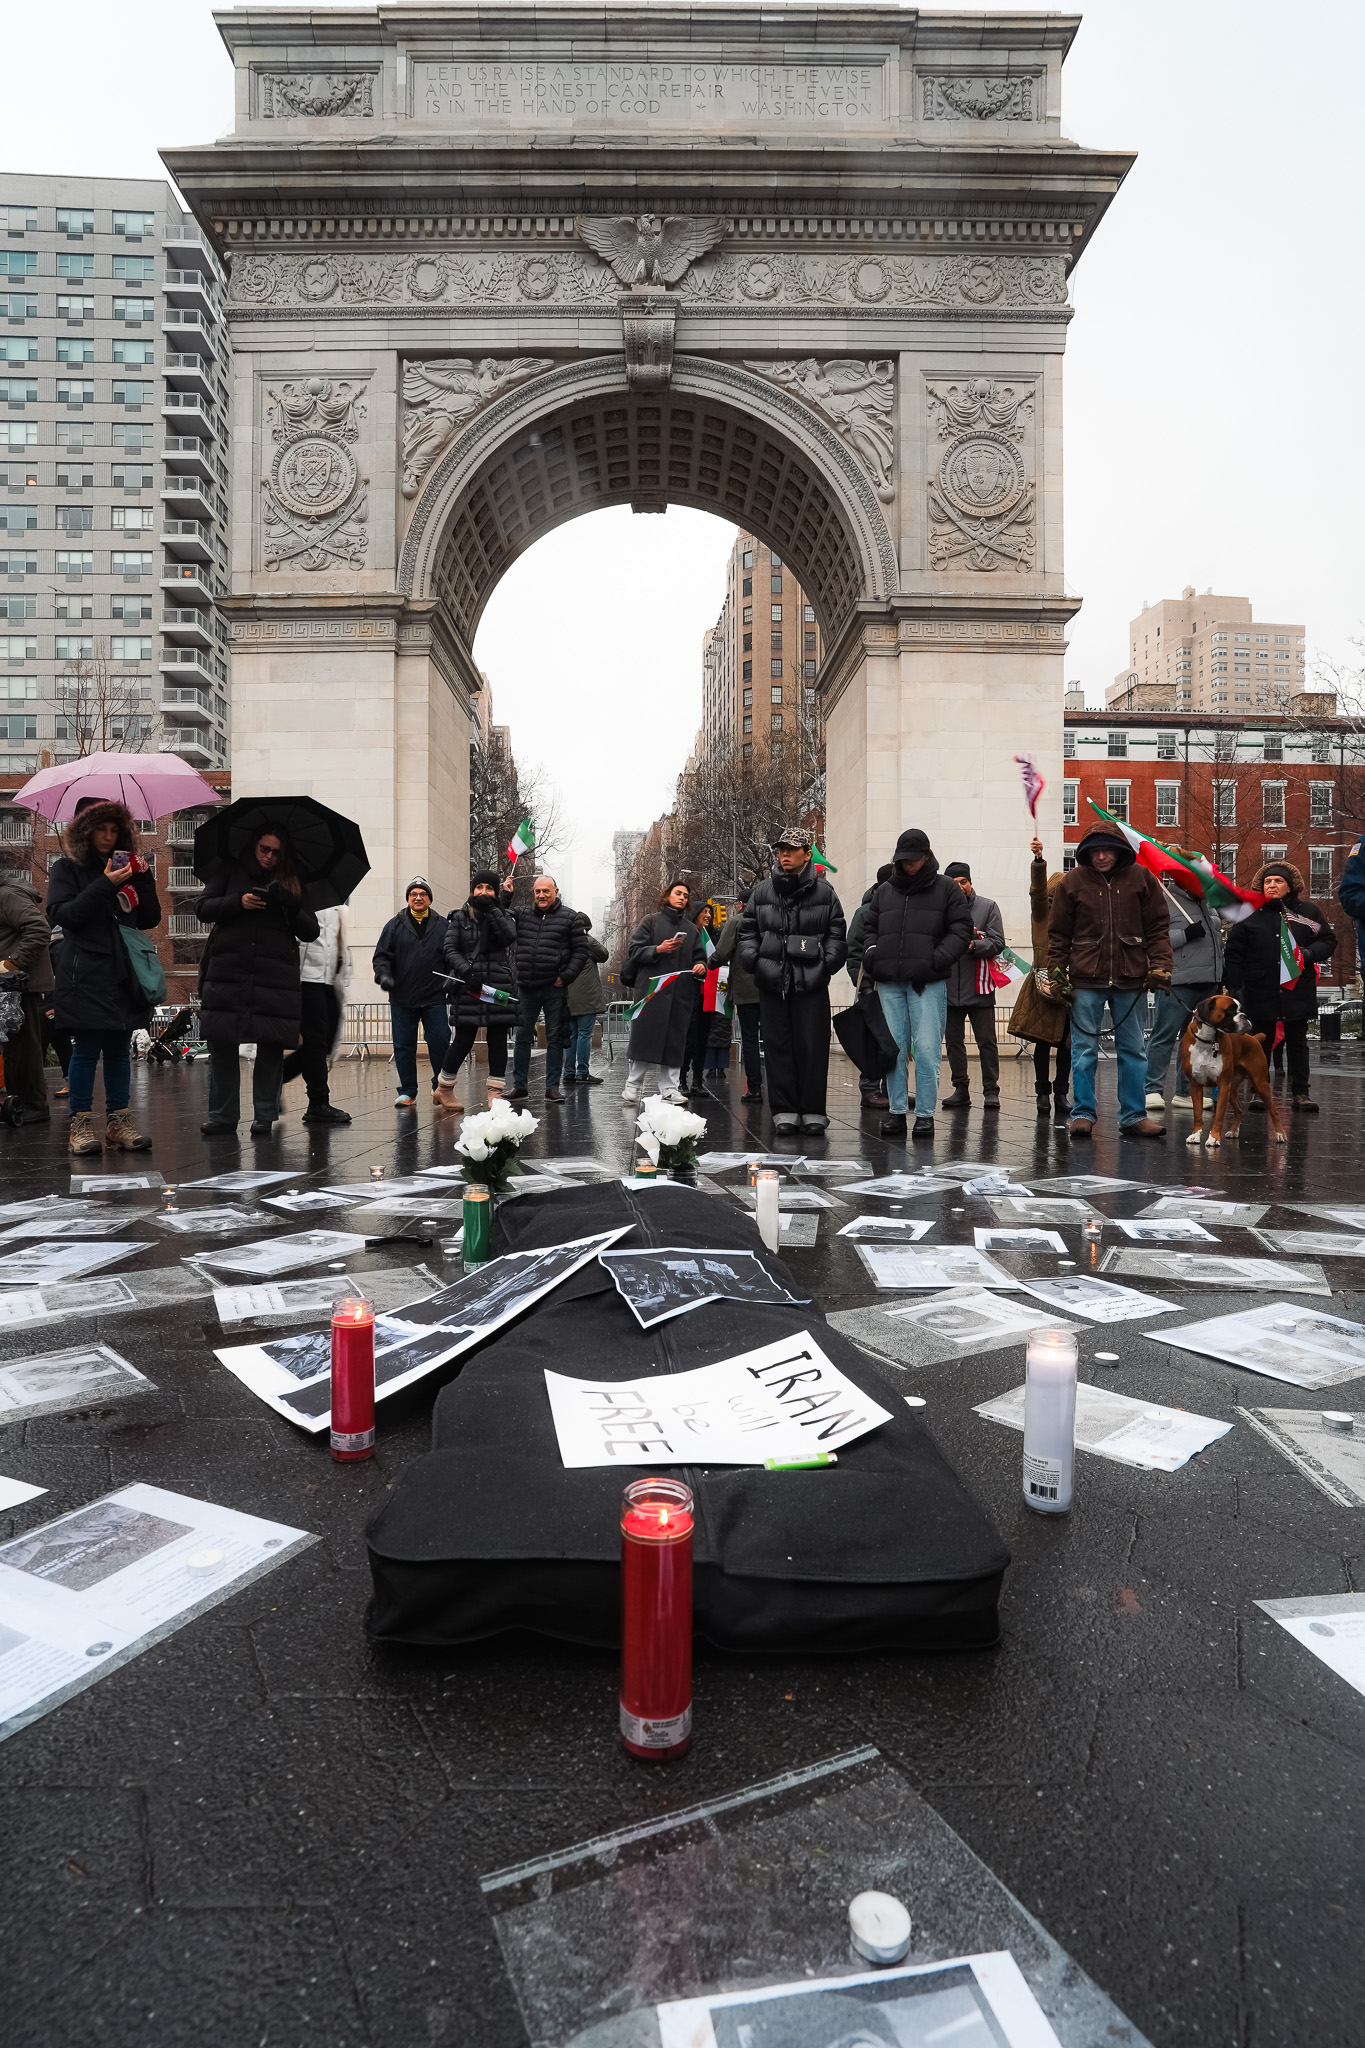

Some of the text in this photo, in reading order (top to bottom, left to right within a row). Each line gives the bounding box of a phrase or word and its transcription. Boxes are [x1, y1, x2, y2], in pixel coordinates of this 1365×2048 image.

[426, 66, 871, 84] LET US RAISE A STANDARD TO WHICH THE WISE
[425, 83, 871, 100] AND THE HONEST CAN REPAIR THE EVENT
[426, 99, 661, 114] IS IN THE HAND OF GOD
[741, 101, 872, 117] WASHINGTON
[746, 1350, 867, 1440] IRAN
[581, 1390, 674, 1456] FREE
[672, 1401, 711, 1436] be
[728, 1394, 780, 1433] will
